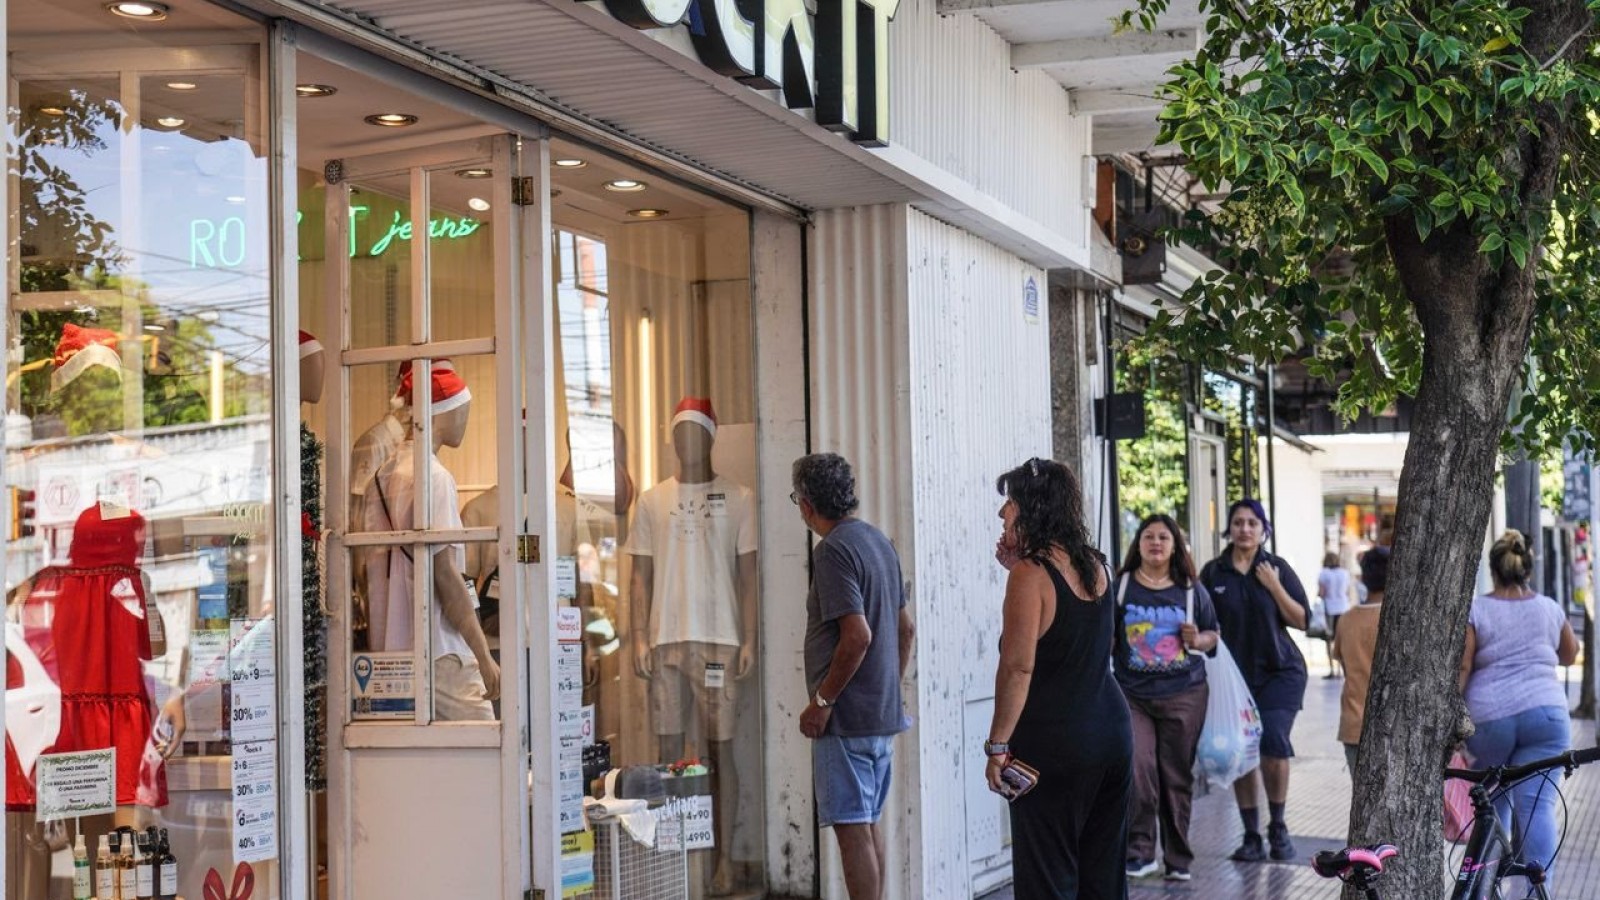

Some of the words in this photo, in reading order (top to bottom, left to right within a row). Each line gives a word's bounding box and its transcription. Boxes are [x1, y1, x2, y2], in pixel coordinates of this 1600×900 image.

[233, 708, 253, 721] 30%
[236, 784, 254, 796] 30%
[238, 836, 256, 849] 40%
